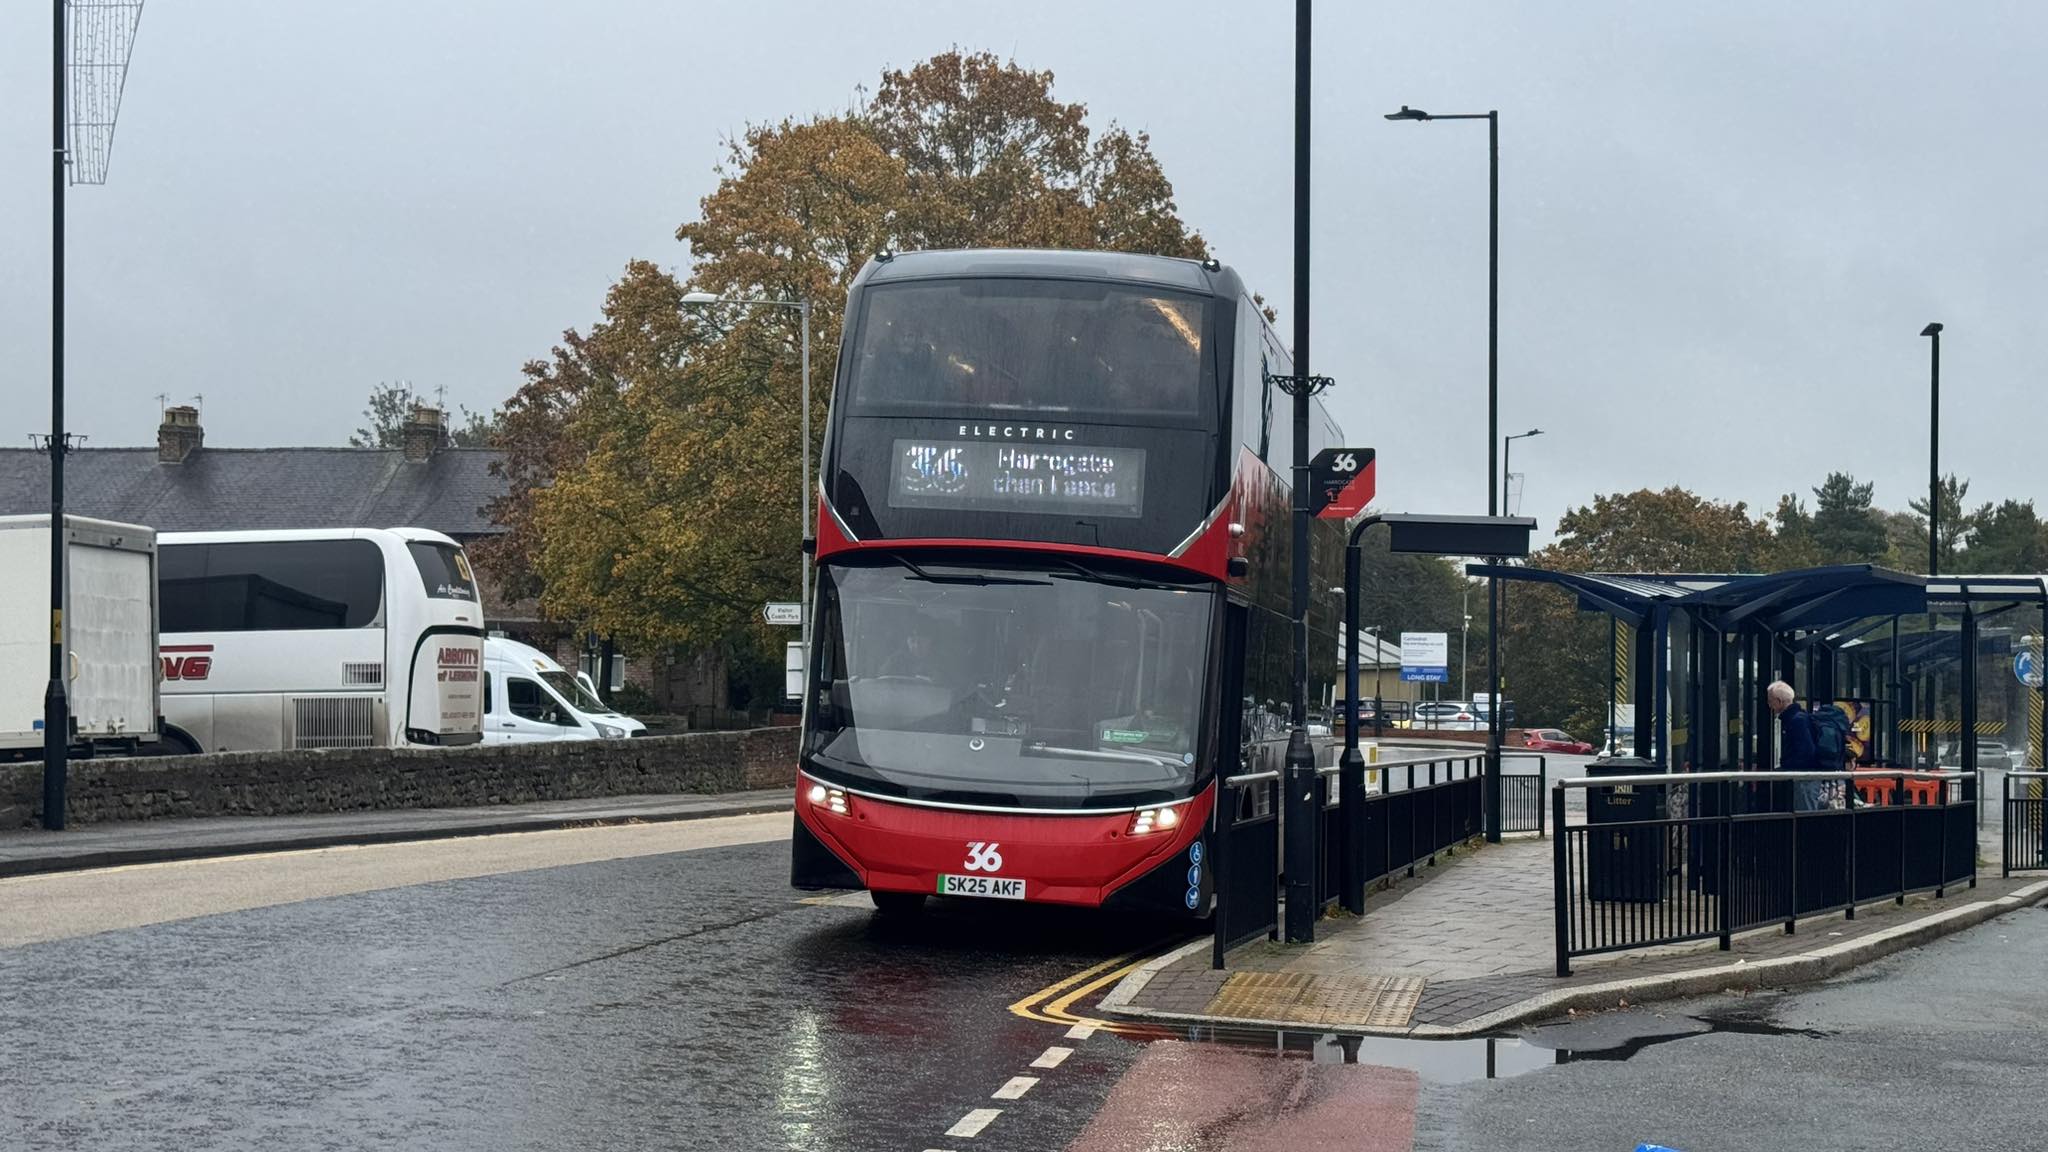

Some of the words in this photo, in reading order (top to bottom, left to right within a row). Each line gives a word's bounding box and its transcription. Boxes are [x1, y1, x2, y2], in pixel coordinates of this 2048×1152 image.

[959, 425, 1074, 440] ELECTRIC
[1331, 453, 1358, 472] 36
[1607, 796, 1633, 805] Litter
[963, 841, 1003, 873] 36
[947, 876, 988, 895] SK25
[991, 879, 1023, 897] AKF
